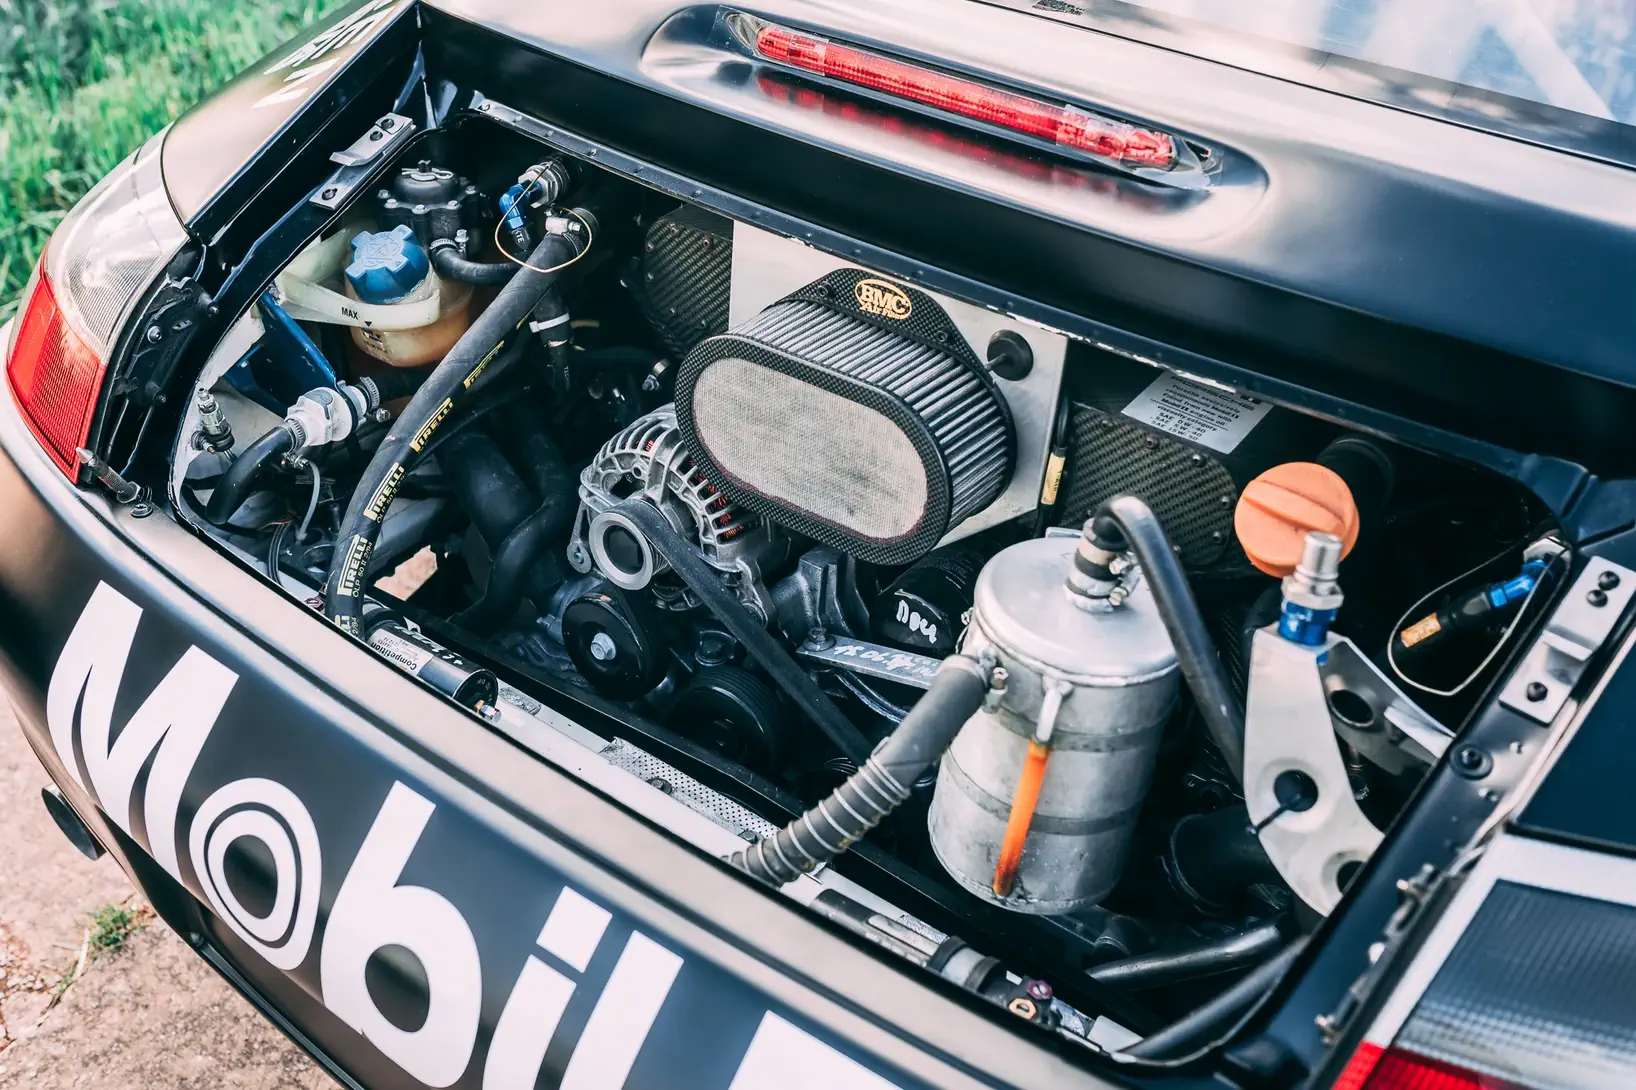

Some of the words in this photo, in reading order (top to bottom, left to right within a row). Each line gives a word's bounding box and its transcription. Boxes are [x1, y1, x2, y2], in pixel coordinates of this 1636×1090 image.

[860, 283, 908, 314] BMC
[341, 307, 359, 320] MAX
[1154, 416, 1170, 424] SAE
[1156, 405, 1187, 418] viscosity
[1186, 417, 1218, 431] category
[1158, 412, 1174, 420] SAE
[1160, 398, 1181, 407] Mobil
[1188, 410, 1215, 421] engine
[1183, 401, 1201, 410] from
[1216, 414, 1232, 422] with
[1210, 406, 1230, 415] Mobil
[409, 397, 453, 452] PIRELLI
[1150, 420, 1167, 428] SAE
[363, 462, 405, 520] PIRELLI
[337, 534, 368, 596] PIRELLI
[352, 580, 361, 598] OLP
[371, 642, 418, 671] Competition
[47, 581, 684, 1090] Mobil
